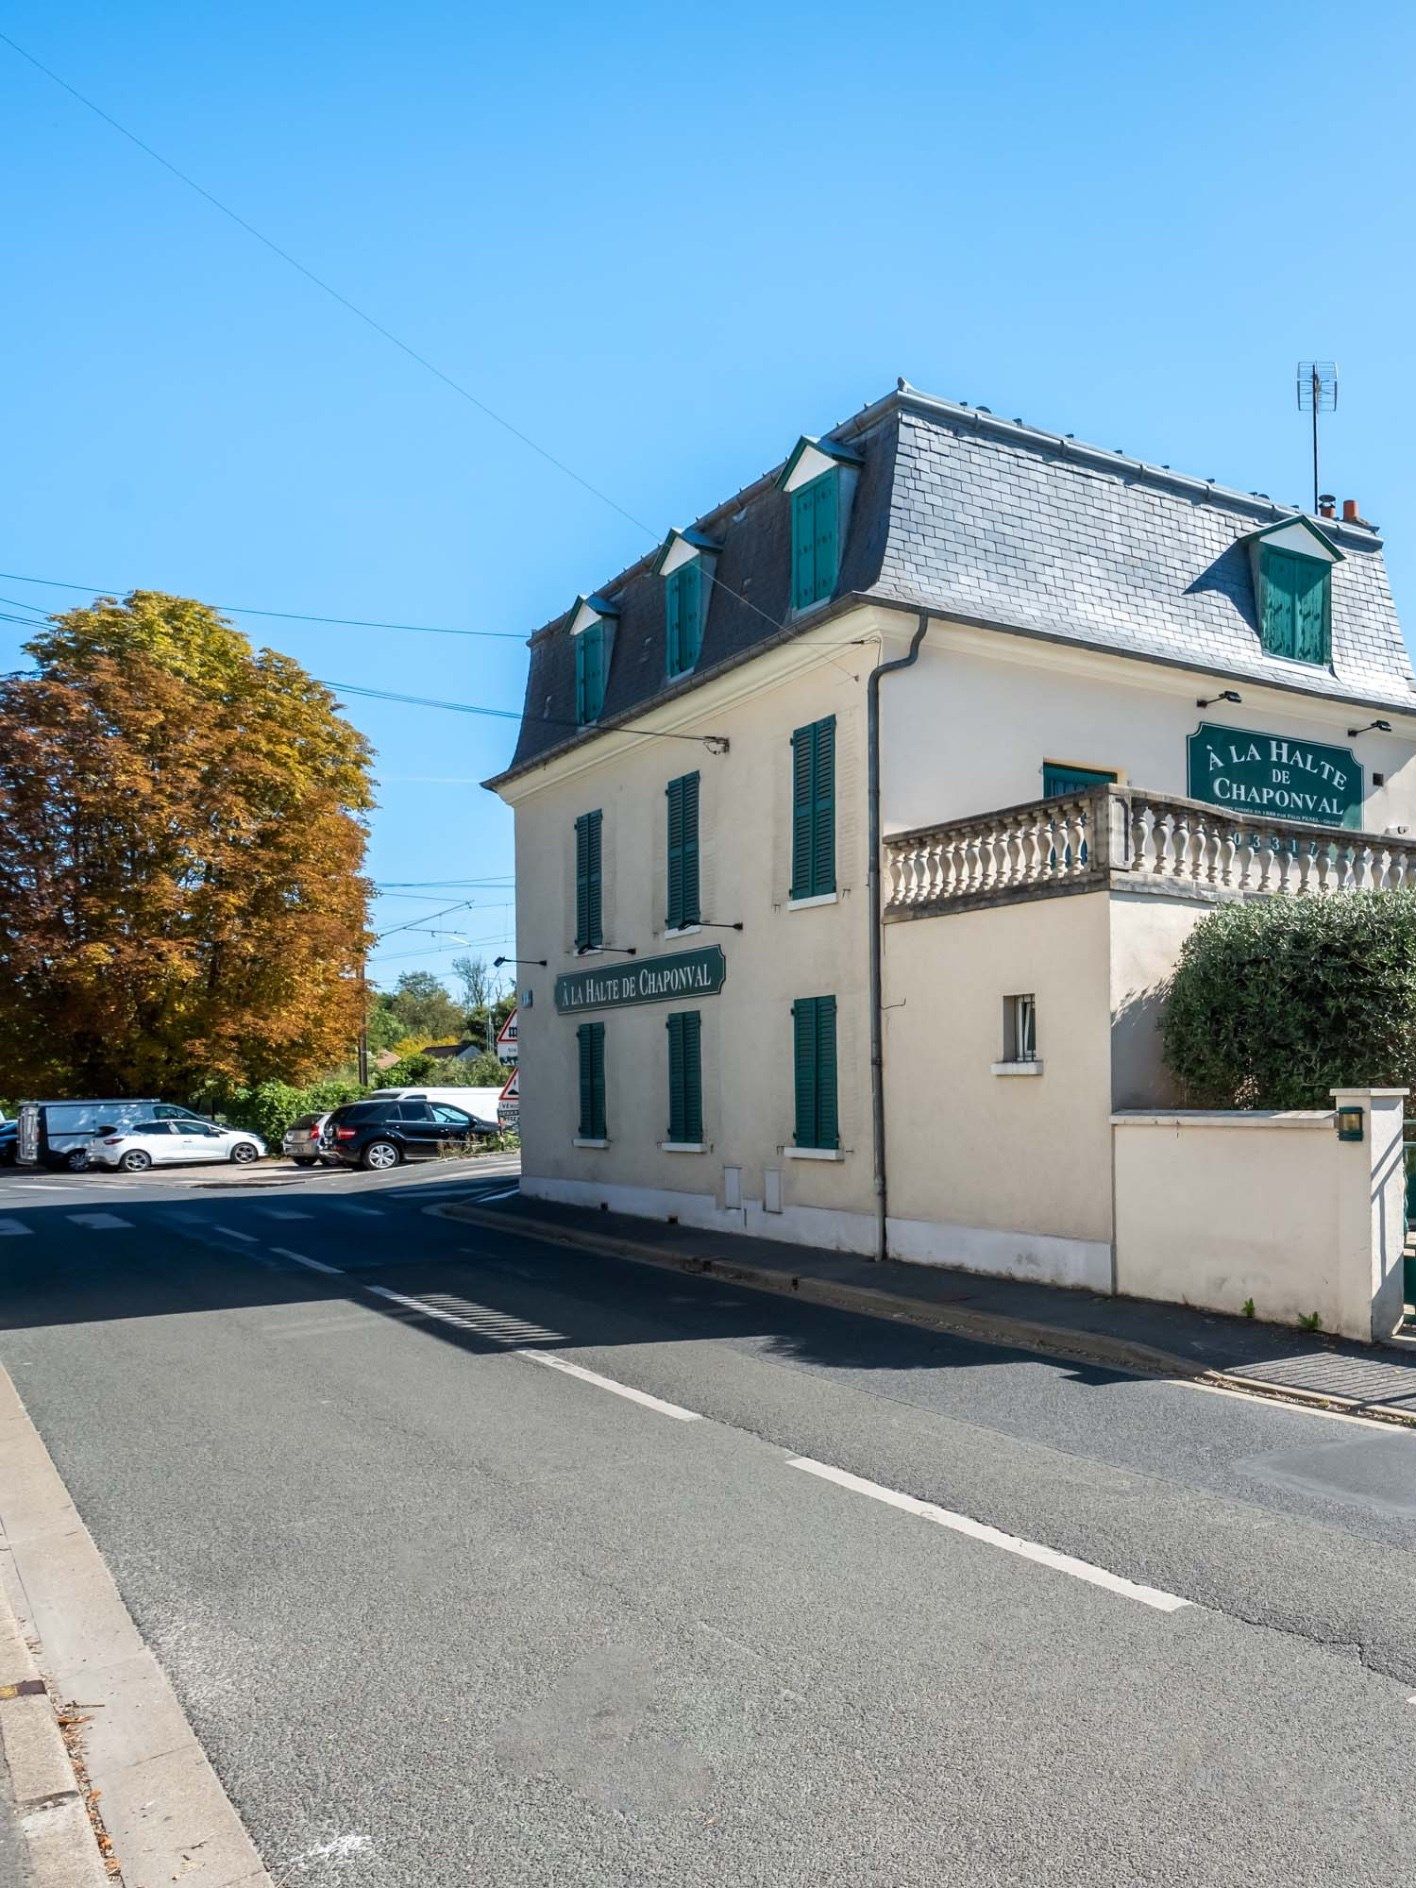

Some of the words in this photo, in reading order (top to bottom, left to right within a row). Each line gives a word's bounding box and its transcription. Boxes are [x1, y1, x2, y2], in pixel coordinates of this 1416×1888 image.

[1206, 745, 1224, 771] À
[1229, 743, 1261, 764] LA
[1270, 740, 1347, 791] HALTE
[1272, 768, 1290, 785] DE
[1213, 777, 1343, 815] CHAPONVAL
[571, 985, 582, 1005] LA
[586, 979, 619, 1003] HALTE
[622, 977, 636, 998] DE
[639, 963, 711, 996] CHAPONVAL
